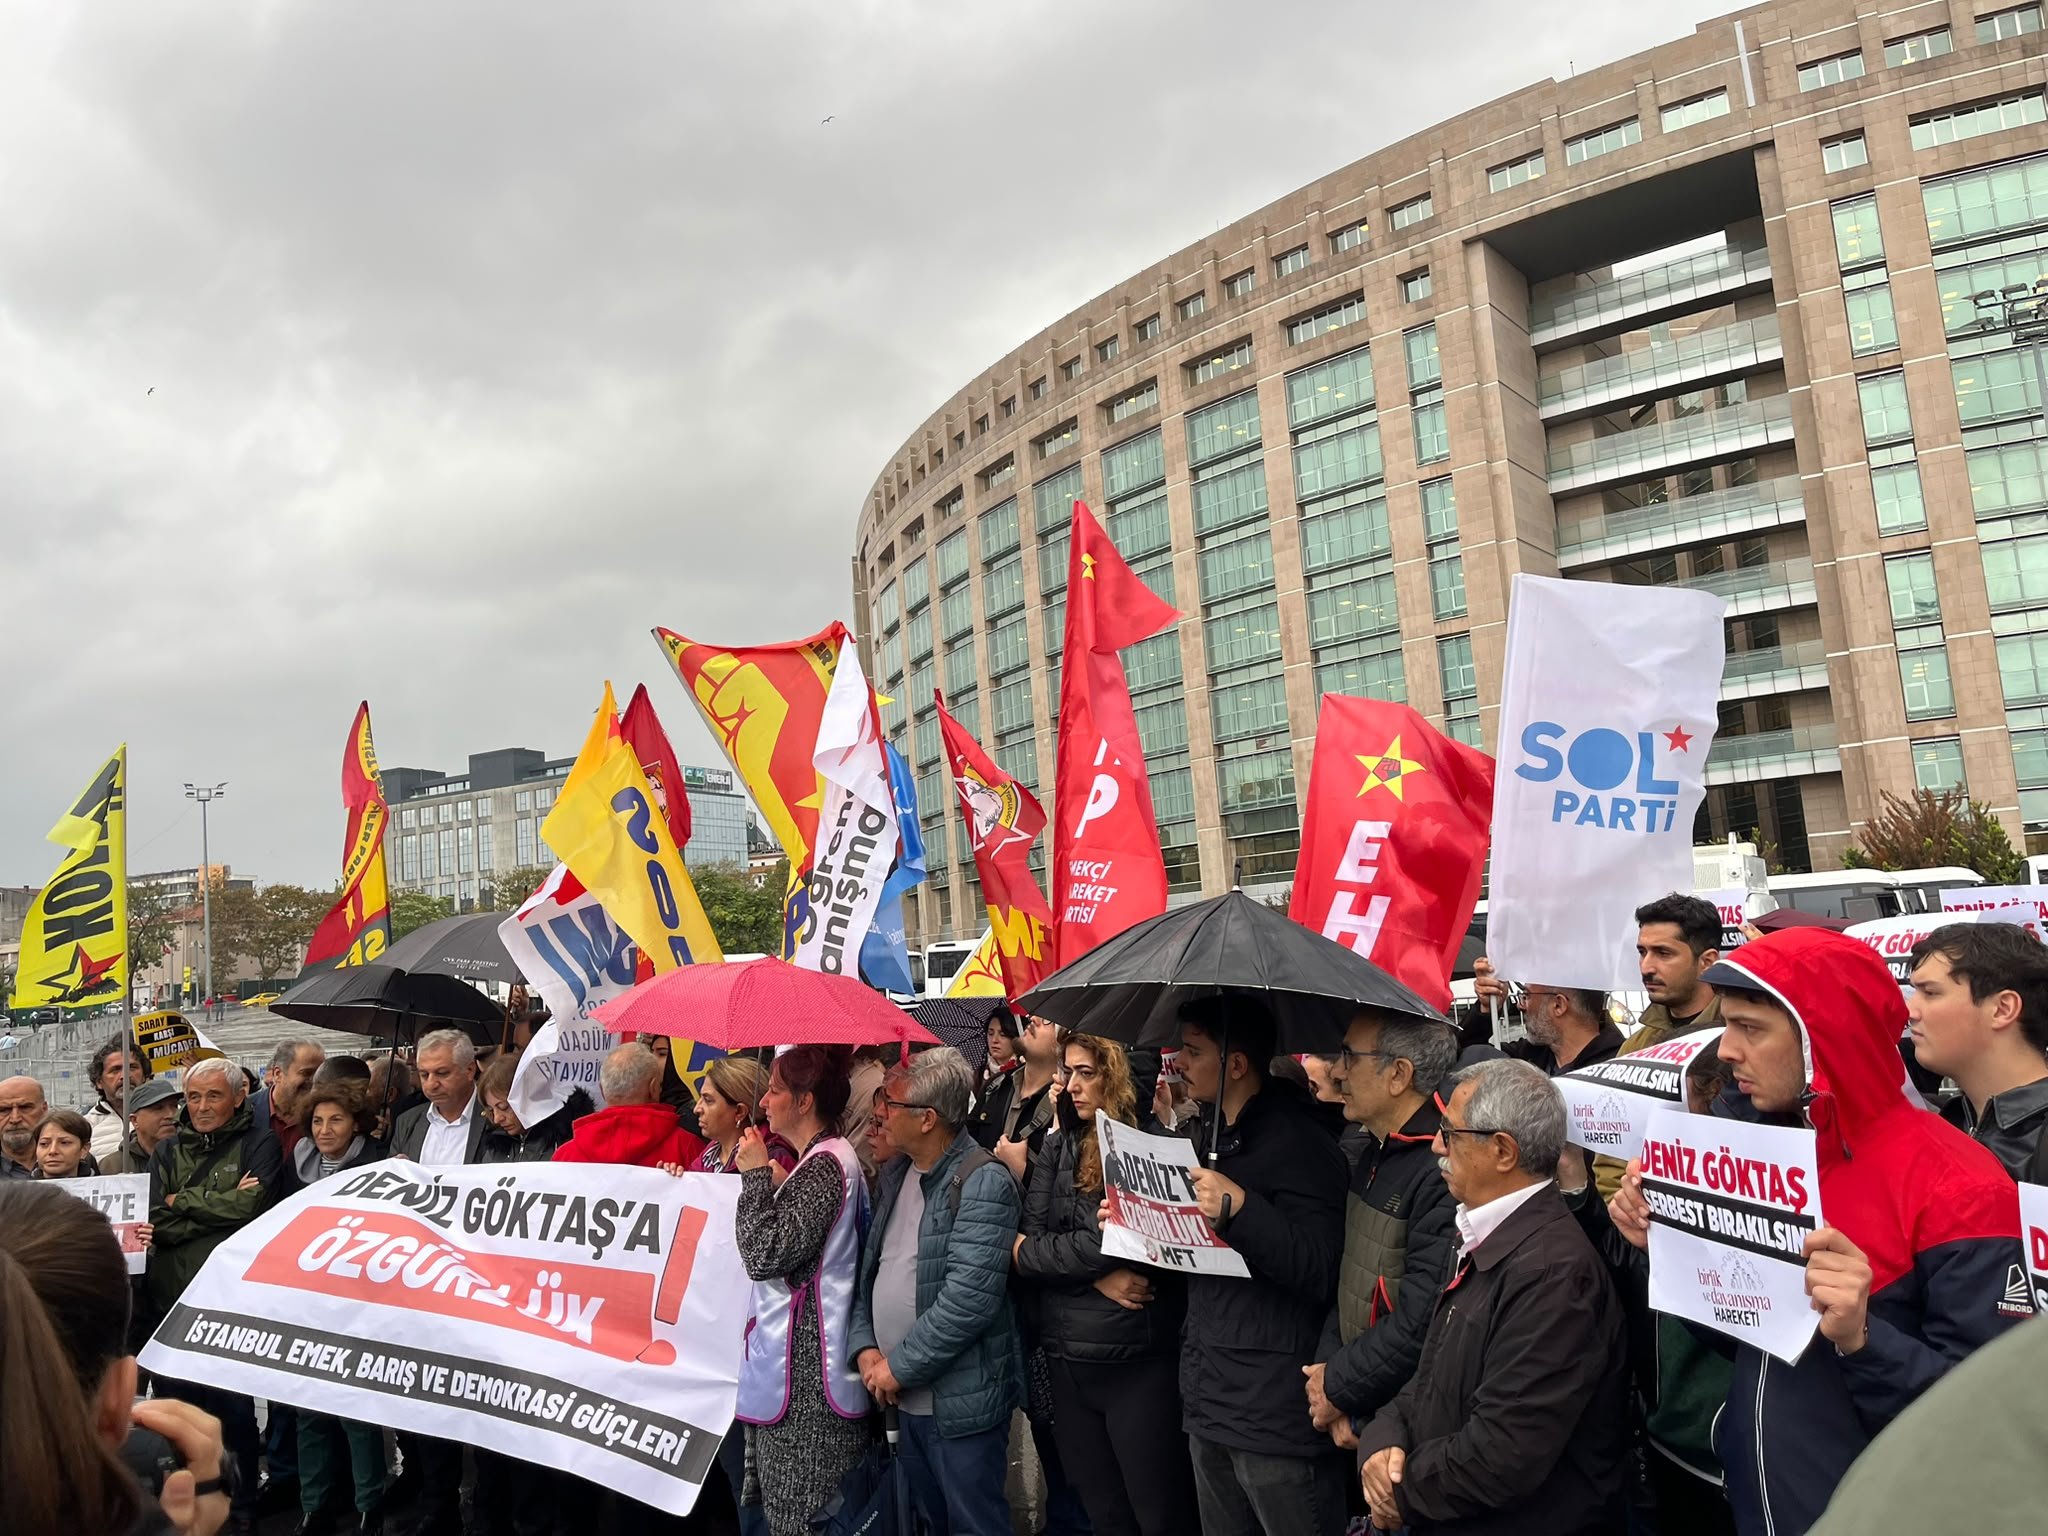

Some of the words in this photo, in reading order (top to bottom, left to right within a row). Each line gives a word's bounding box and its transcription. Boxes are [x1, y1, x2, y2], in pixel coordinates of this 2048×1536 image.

[1514, 721, 1680, 796] SOL
[820, 803, 888, 976] anışma
[138, 1016, 166, 1032] SARAY
[1601, 1063, 1680, 1094] BIRAKILSIN!
[1639, 1137, 1700, 1186] DENİZ
[1702, 1145, 1809, 1215] GÖKTAŞ
[331, 1170, 461, 1229] DENİZ
[462, 1176, 662, 1260] GÖKTAŞ'A
[1643, 1187, 1705, 1230] SERBEST
[1159, 1244, 1199, 1269] MFT
[1696, 1267, 1722, 1288] birlik
[1997, 1301, 2034, 1314] TRIBORD
[184, 1312, 283, 1363] İSTANBUL
[285, 1337, 351, 1379] EMEK,
[355, 1350, 419, 1395] BARIŞ
[420, 1365, 448, 1395] VE
[450, 1370, 574, 1424] DEMOKRASİ
[570, 1403, 692, 1466] GÜÇLERİ
